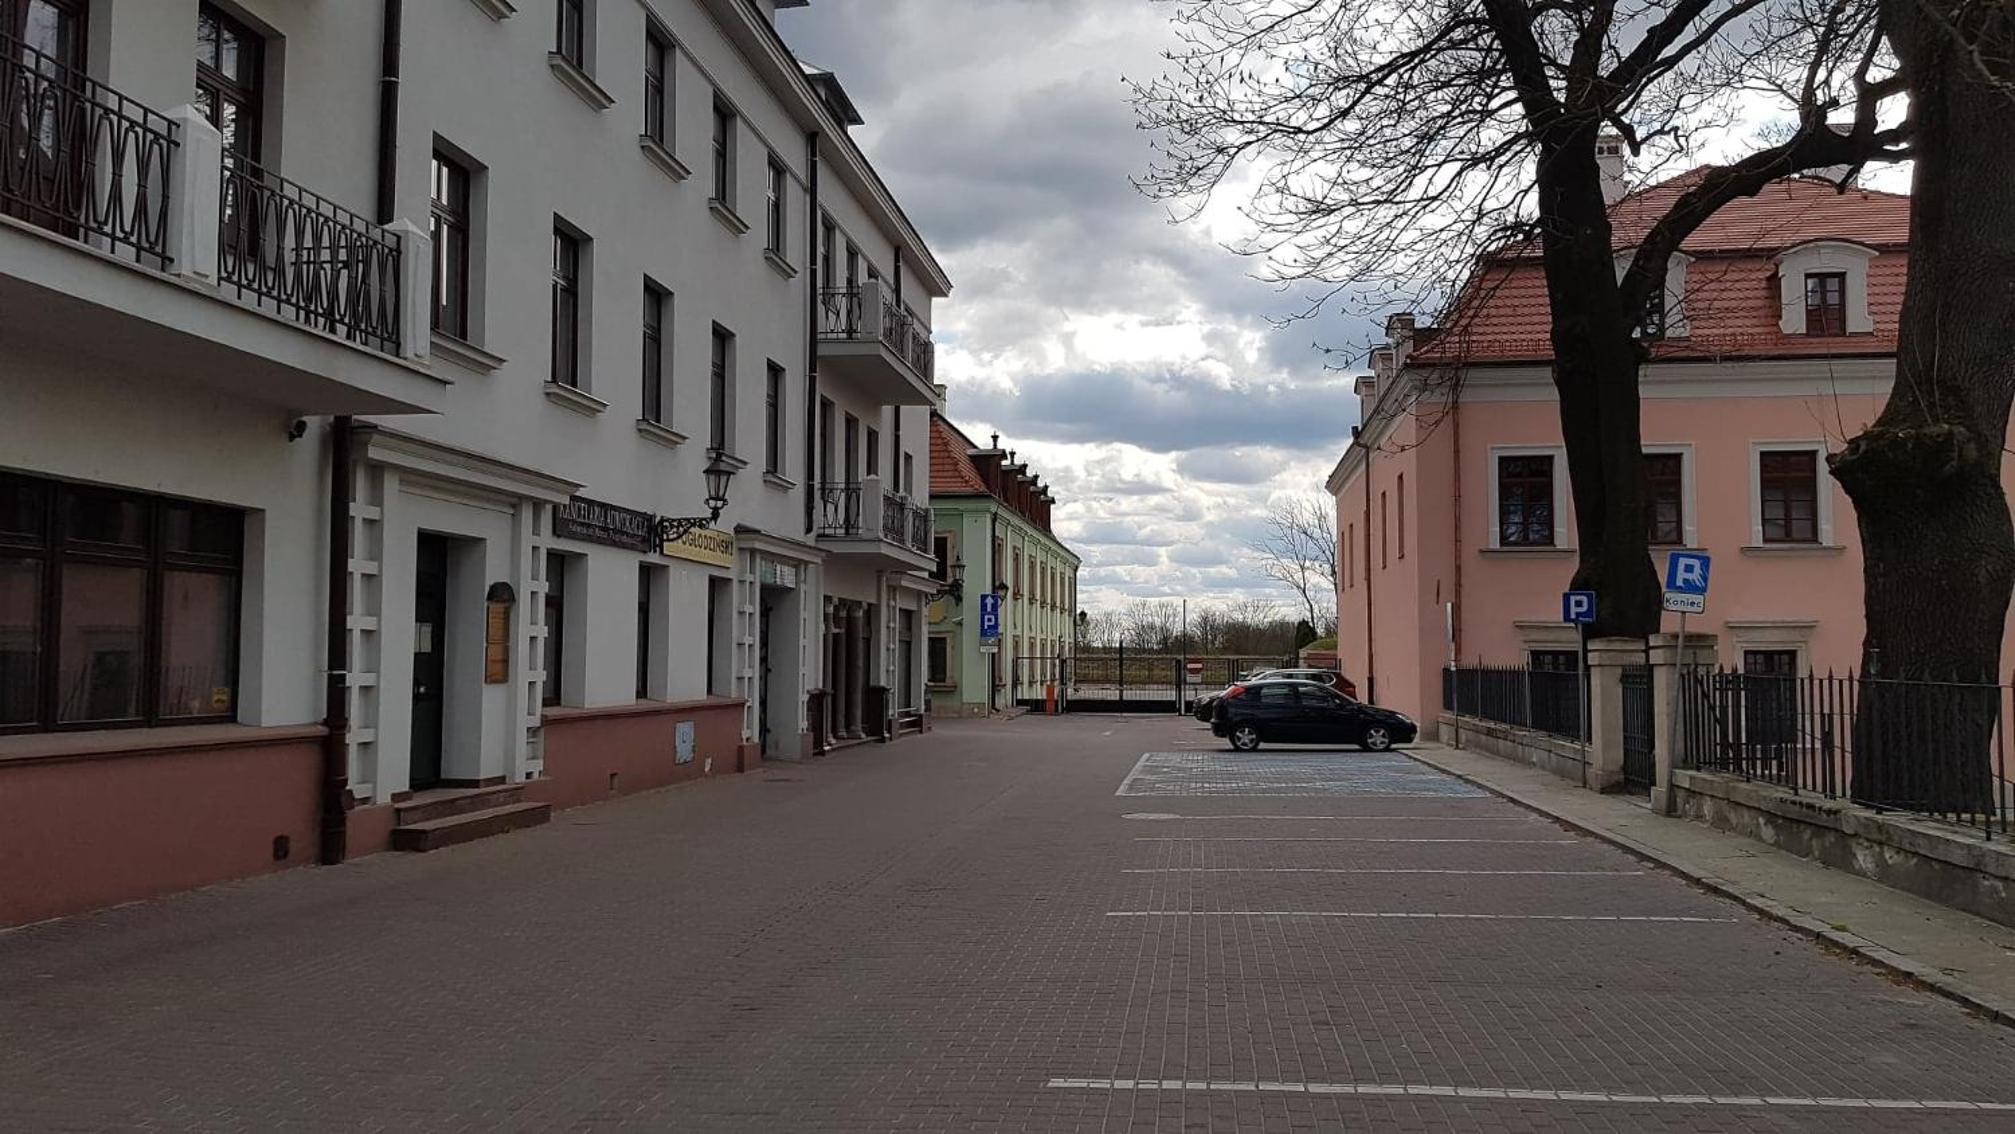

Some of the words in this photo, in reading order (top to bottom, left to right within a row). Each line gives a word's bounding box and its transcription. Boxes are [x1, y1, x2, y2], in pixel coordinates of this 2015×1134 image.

[559, 500, 606, 528] KANCELARIA
[676, 531, 734, 556] OGŁODZIŃSKI
[1570, 595, 1588, 619] P
[1665, 596, 1703, 608] Koniec
[984, 615, 995, 630] P
